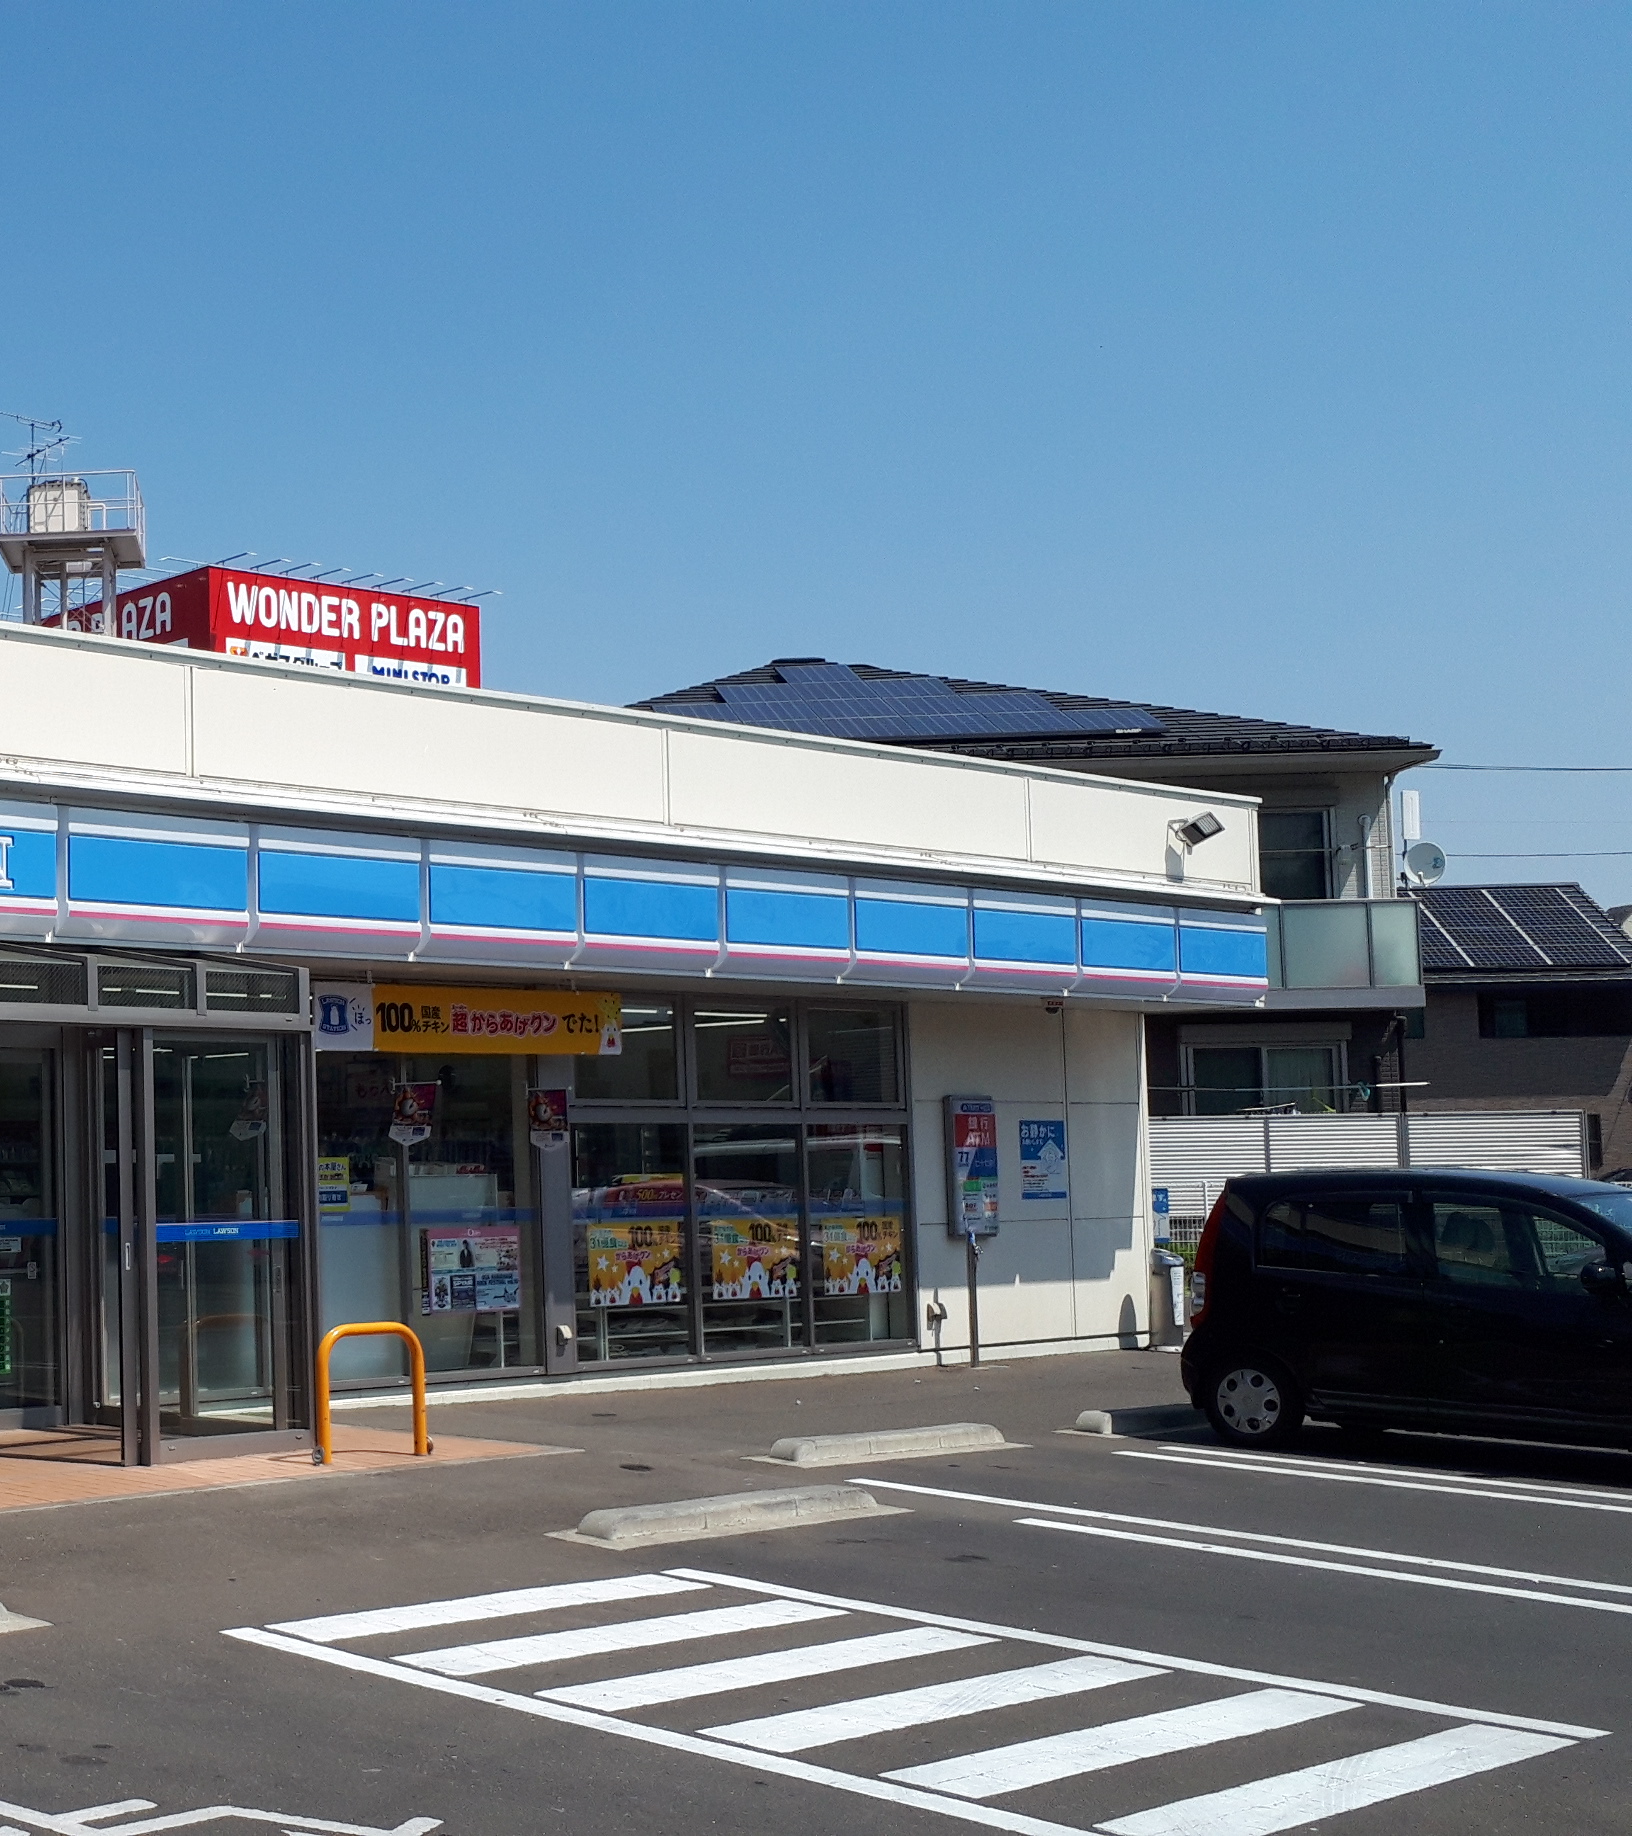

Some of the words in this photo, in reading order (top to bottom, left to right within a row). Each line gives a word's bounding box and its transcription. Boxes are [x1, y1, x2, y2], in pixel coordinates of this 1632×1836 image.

[227, 580, 360, 640] WONDER
[371, 603, 465, 654] PLAZA
[421, 1005, 441, 1019] 国産
[422, 1020, 449, 1033] チキン
[1021, 1124, 1055, 1138] お静かに
[965, 1131, 990, 1146] ATM
